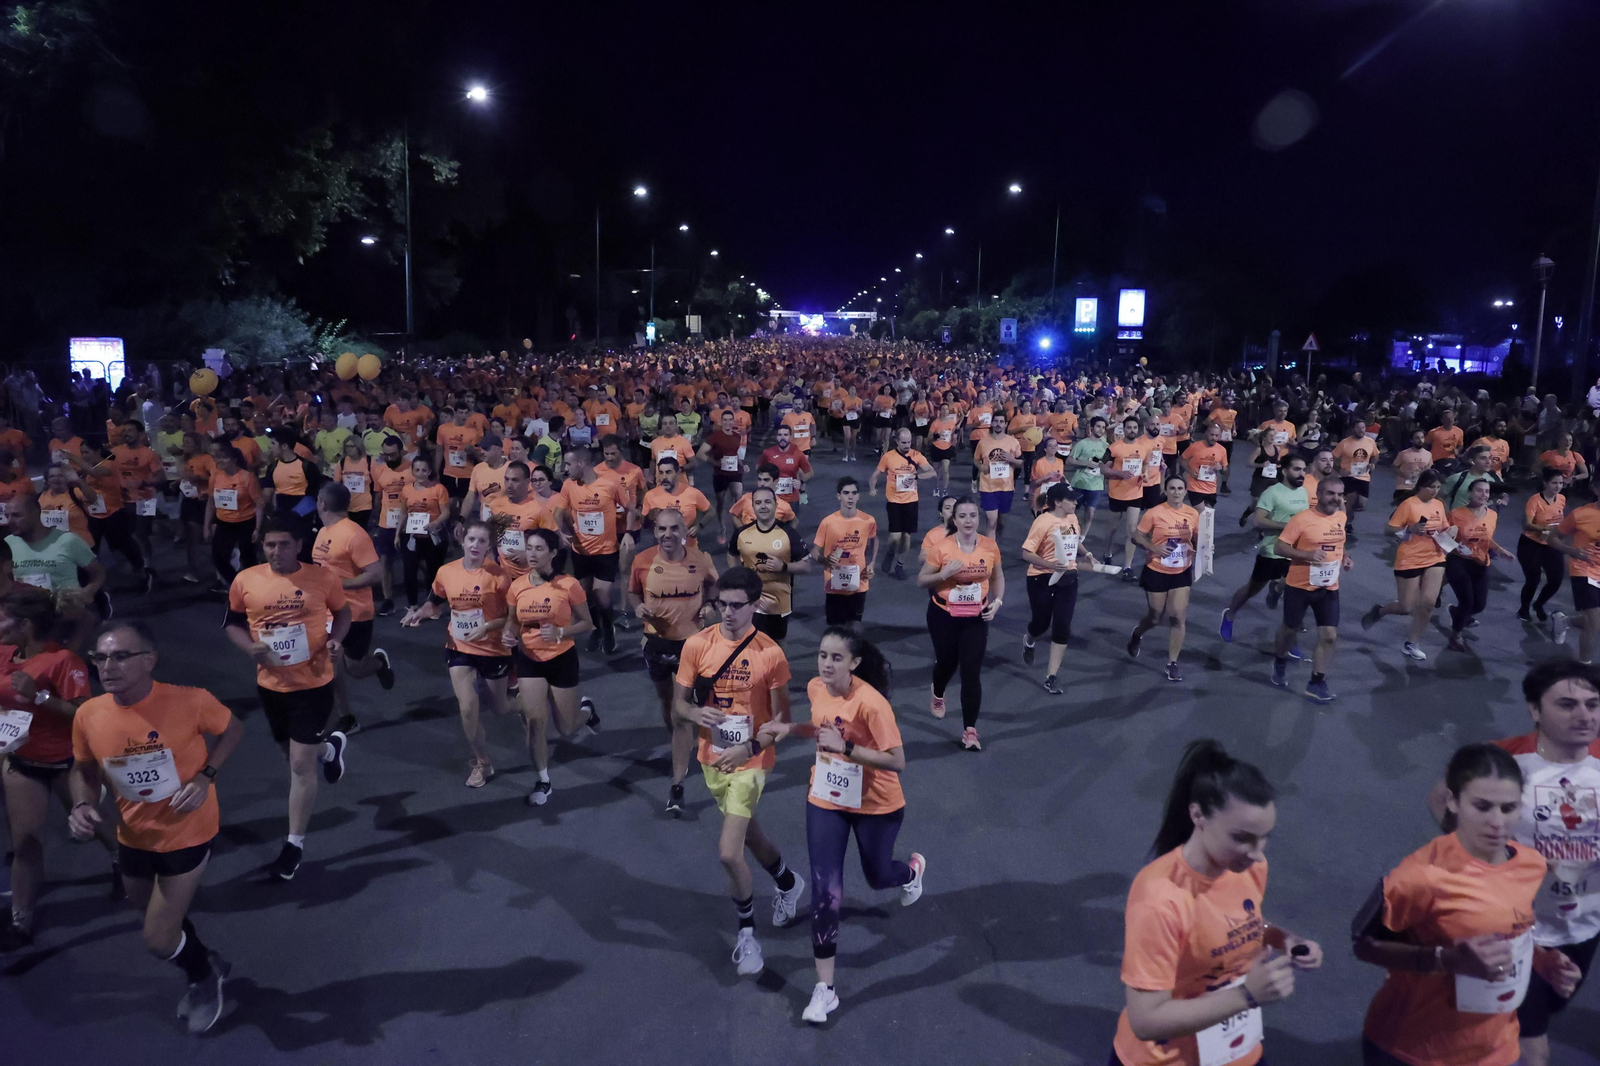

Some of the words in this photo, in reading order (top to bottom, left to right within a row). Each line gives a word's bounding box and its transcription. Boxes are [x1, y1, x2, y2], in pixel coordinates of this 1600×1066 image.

[838, 573, 852, 581] 5847
[958, 593, 975, 601] 5166
[456, 620, 478, 630] 20814
[273, 639, 296, 651] 8007
[127, 769, 160, 785] 3323
[826, 771, 849, 788] 6329
